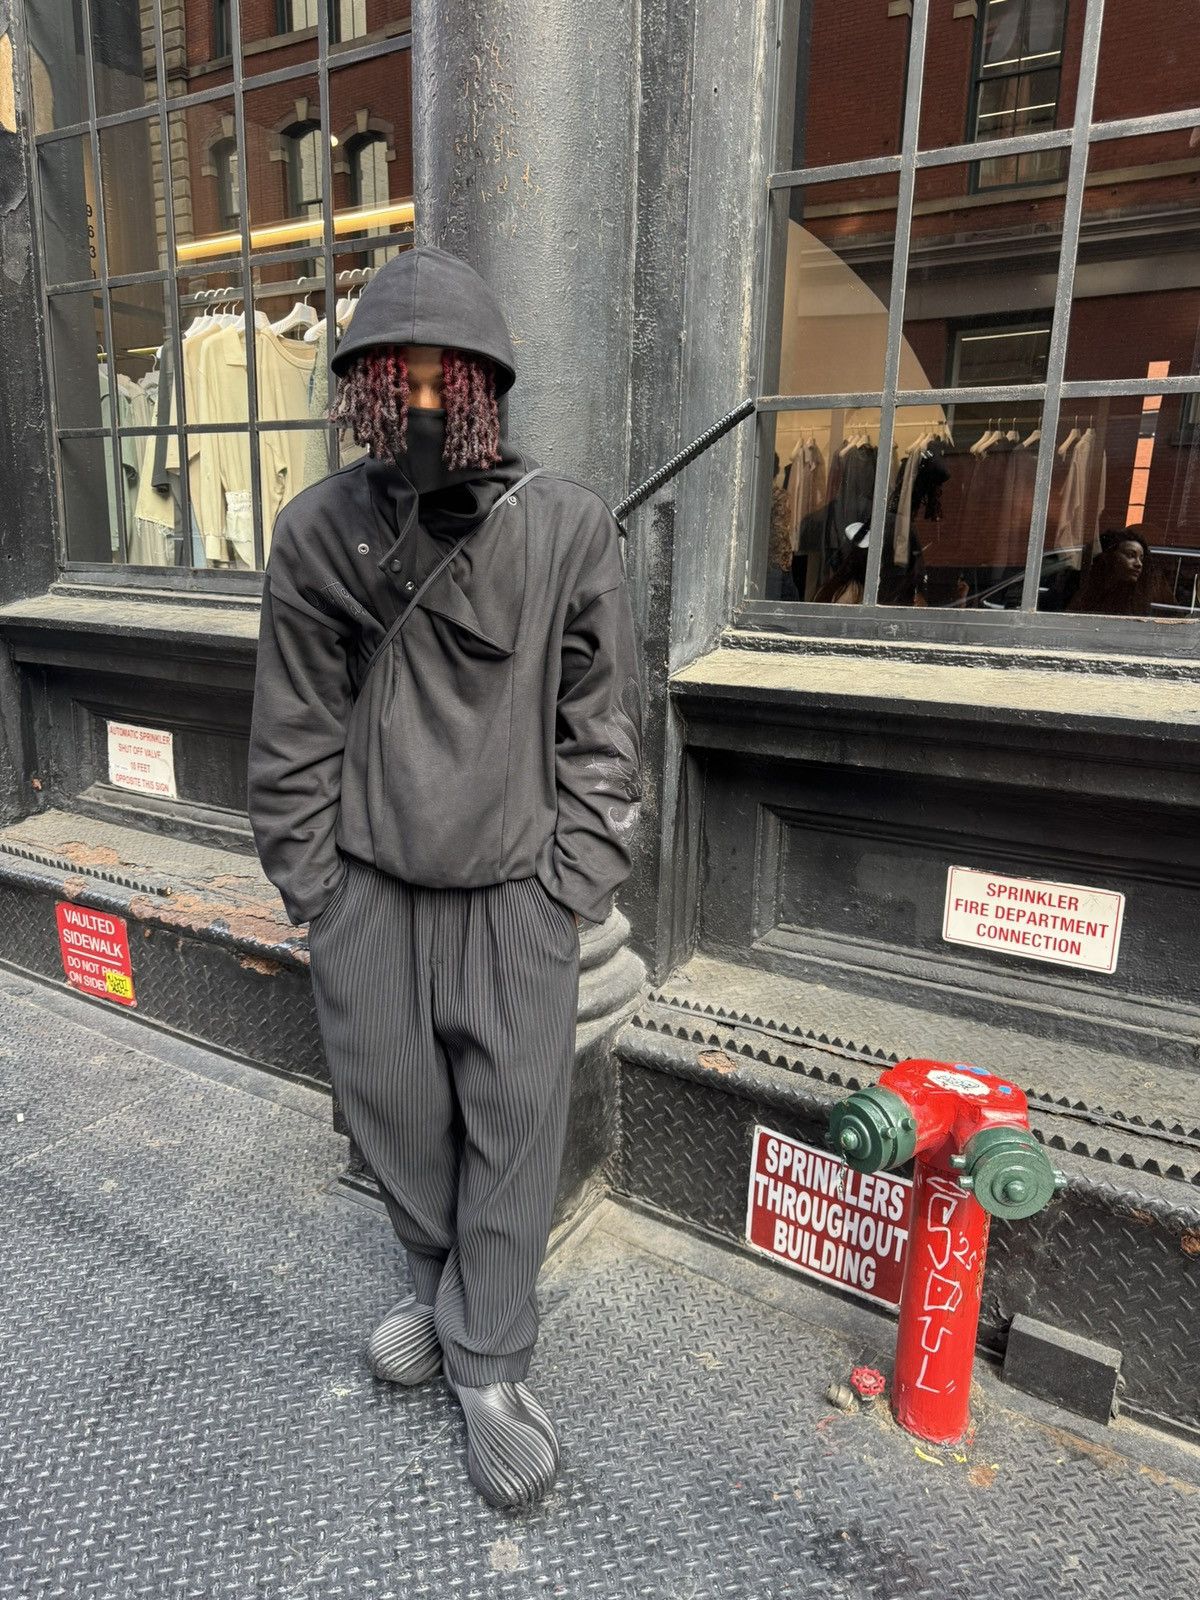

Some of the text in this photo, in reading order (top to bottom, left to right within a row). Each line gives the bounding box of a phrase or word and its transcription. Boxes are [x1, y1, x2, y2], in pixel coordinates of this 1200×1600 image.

[109, 725, 139, 740] AUTOMATIC
[118, 743, 132, 754] SHUT
[133, 746, 143, 756] OFF
[115, 773, 169, 793] OPPOSITE THIS SIGN
[986, 882, 1079, 912] SPRINKLER
[63, 908, 115, 935] VAULTED
[954, 898, 1110, 939] FIRE DEPARTMENT
[62, 928, 124, 959] SIDEWALK
[976, 923, 1082, 956] CONNECTION
[67, 955, 81, 969] DO
[82, 959, 99, 975] NOT
[69, 970, 82, 985] ON
[83, 975, 107, 992] SIDE
[765, 1138, 905, 1222] SPRINKLERS
[755, 1172, 909, 1263] THROUGHOUT
[773, 1218, 877, 1290] BUILDING
